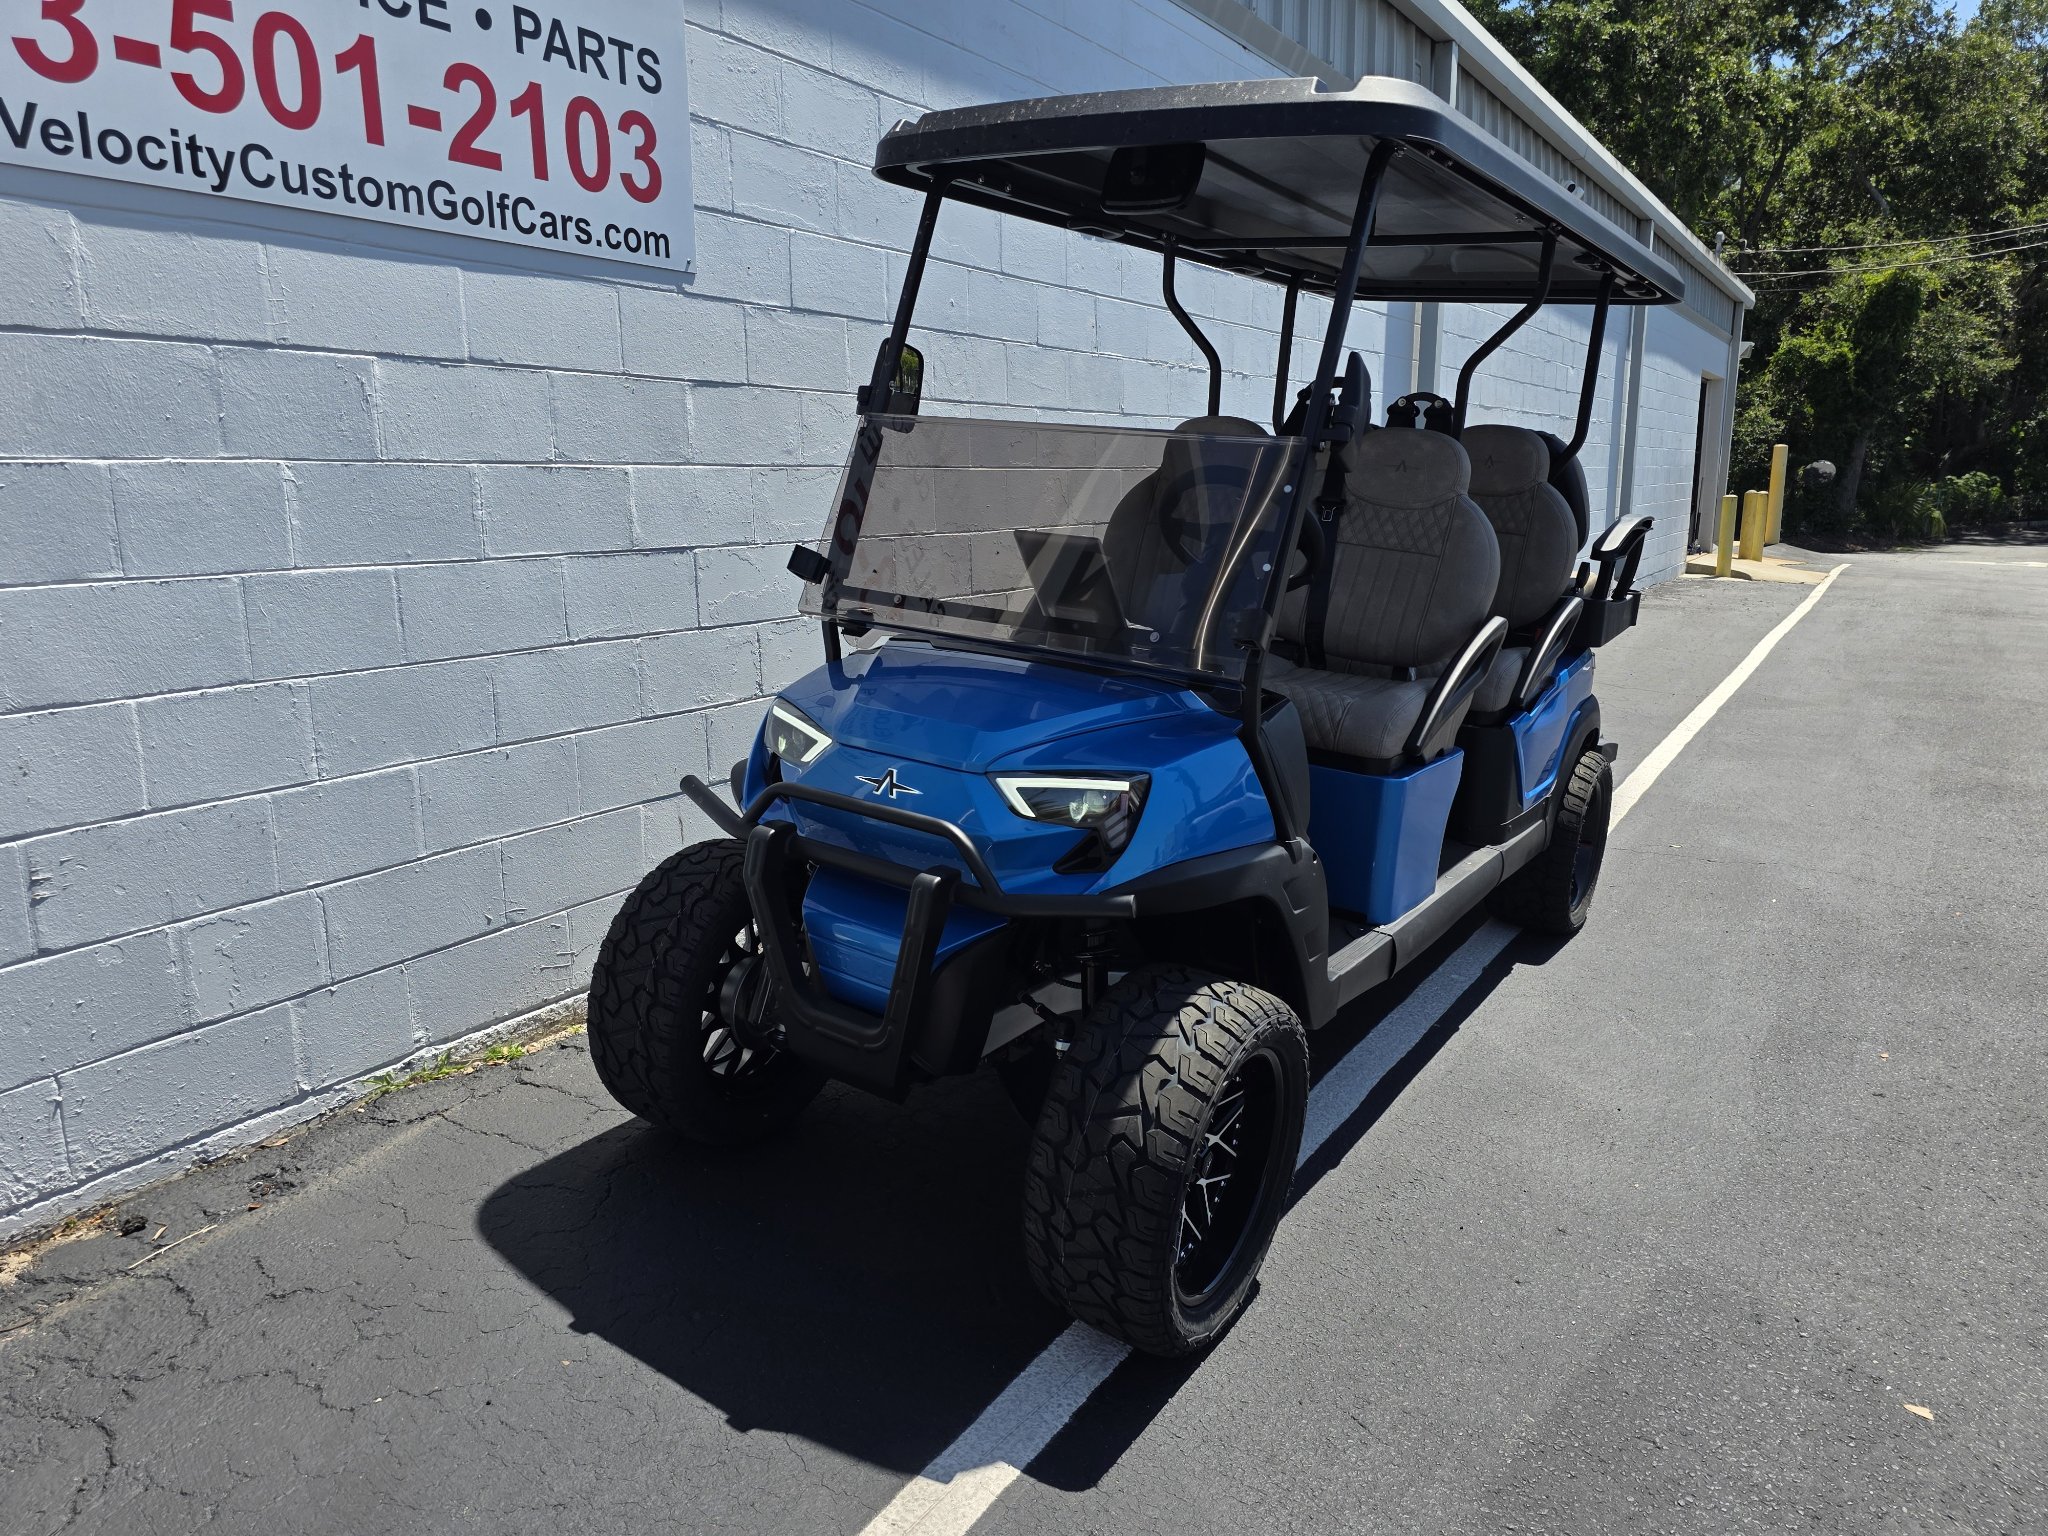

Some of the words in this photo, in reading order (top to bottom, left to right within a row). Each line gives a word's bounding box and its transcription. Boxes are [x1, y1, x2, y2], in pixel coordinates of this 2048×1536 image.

[11, 0, 663, 204] 3-501-2103
[513, 4, 662, 95] PARTS
[0, 97, 671, 259] VelocityCustomGolfCars.com
